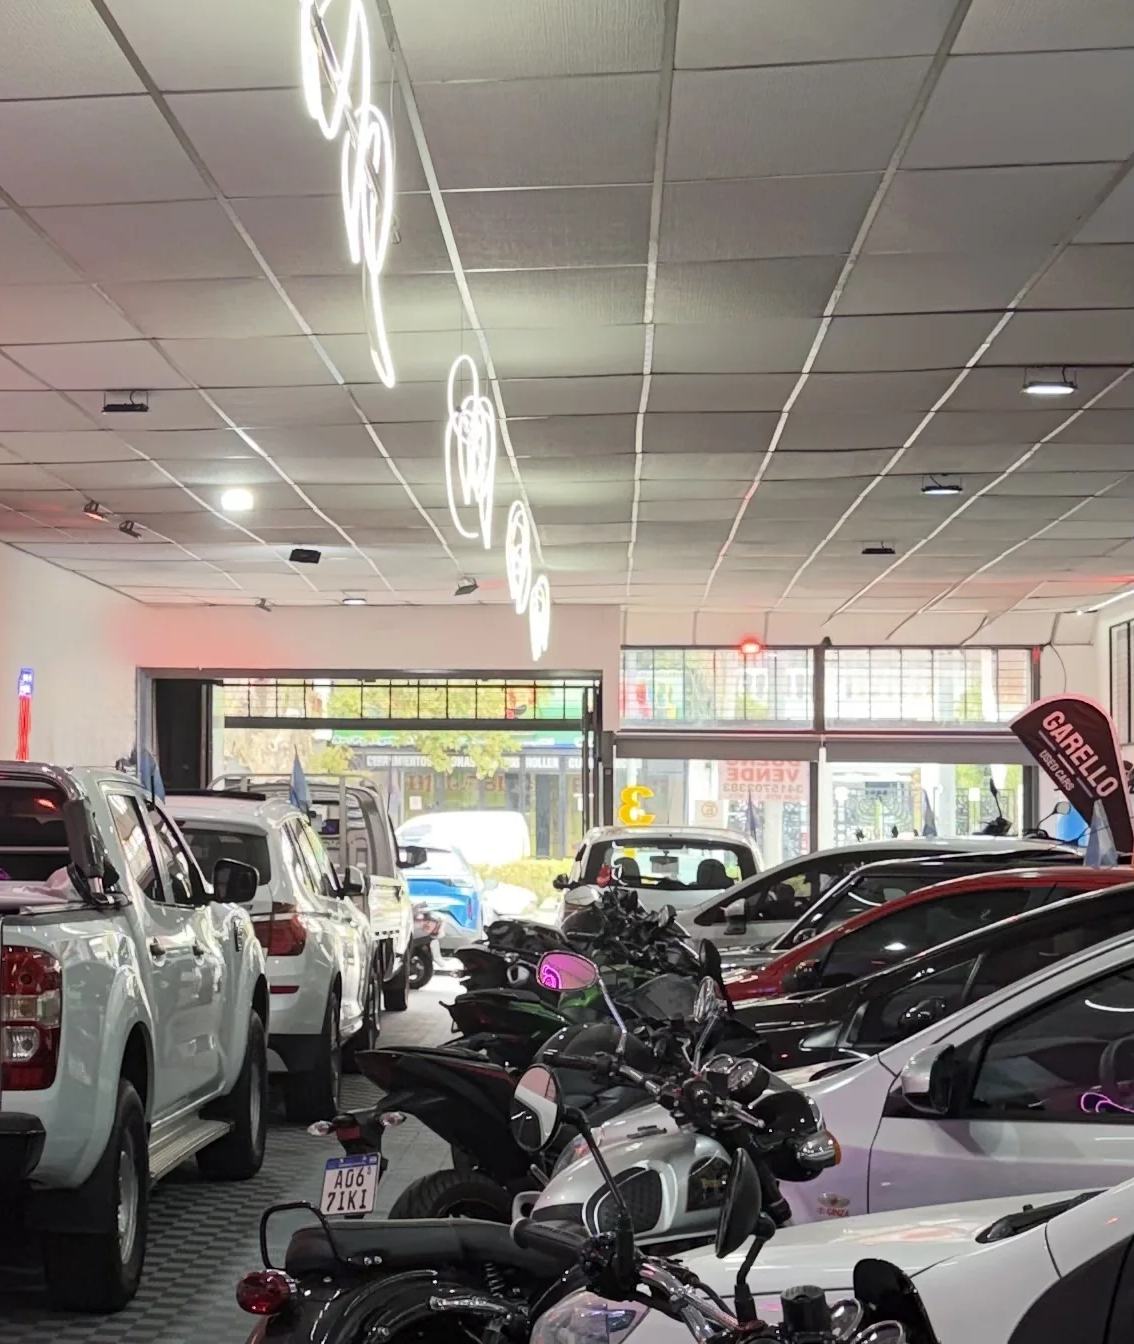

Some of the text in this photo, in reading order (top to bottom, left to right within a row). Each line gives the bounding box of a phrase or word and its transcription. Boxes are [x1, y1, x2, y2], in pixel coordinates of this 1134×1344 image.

[1039, 749, 1075, 792] USED CARS
[1043, 711, 1119, 797] GARELLO
